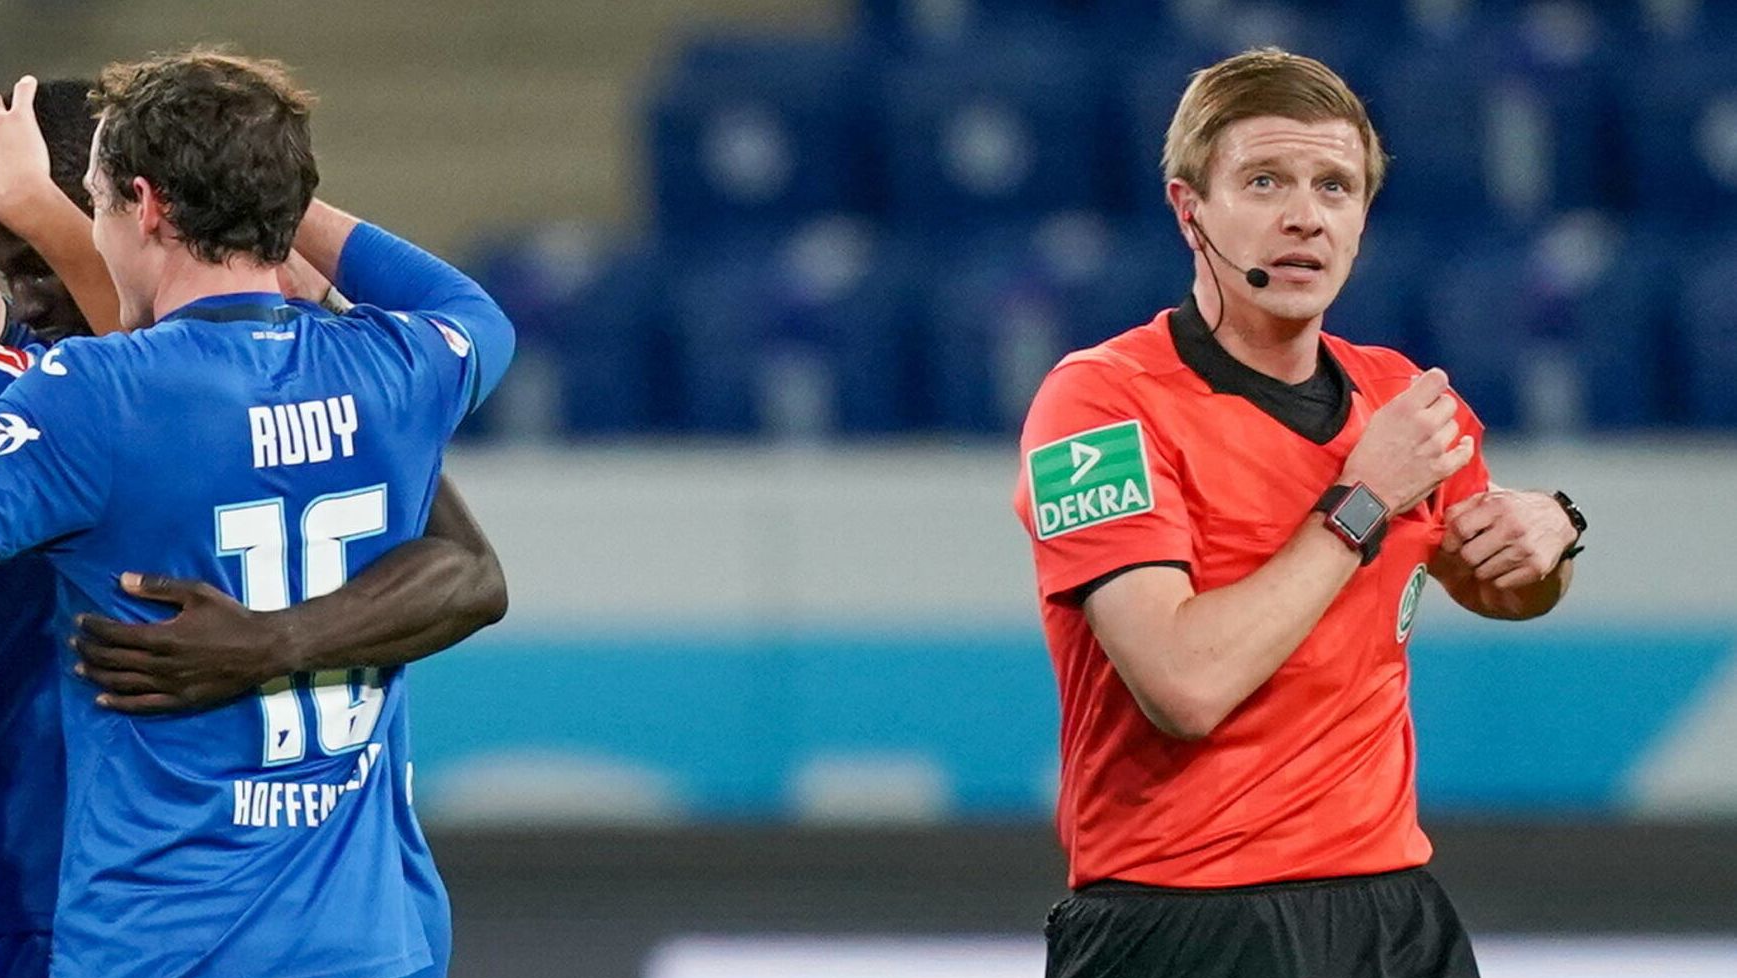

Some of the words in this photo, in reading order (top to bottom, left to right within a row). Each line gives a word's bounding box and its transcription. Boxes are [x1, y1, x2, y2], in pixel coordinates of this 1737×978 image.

[248, 395, 358, 468] RUDY
[1039, 478, 1147, 534] DEKRA
[233, 742, 382, 828] HOFFEN
